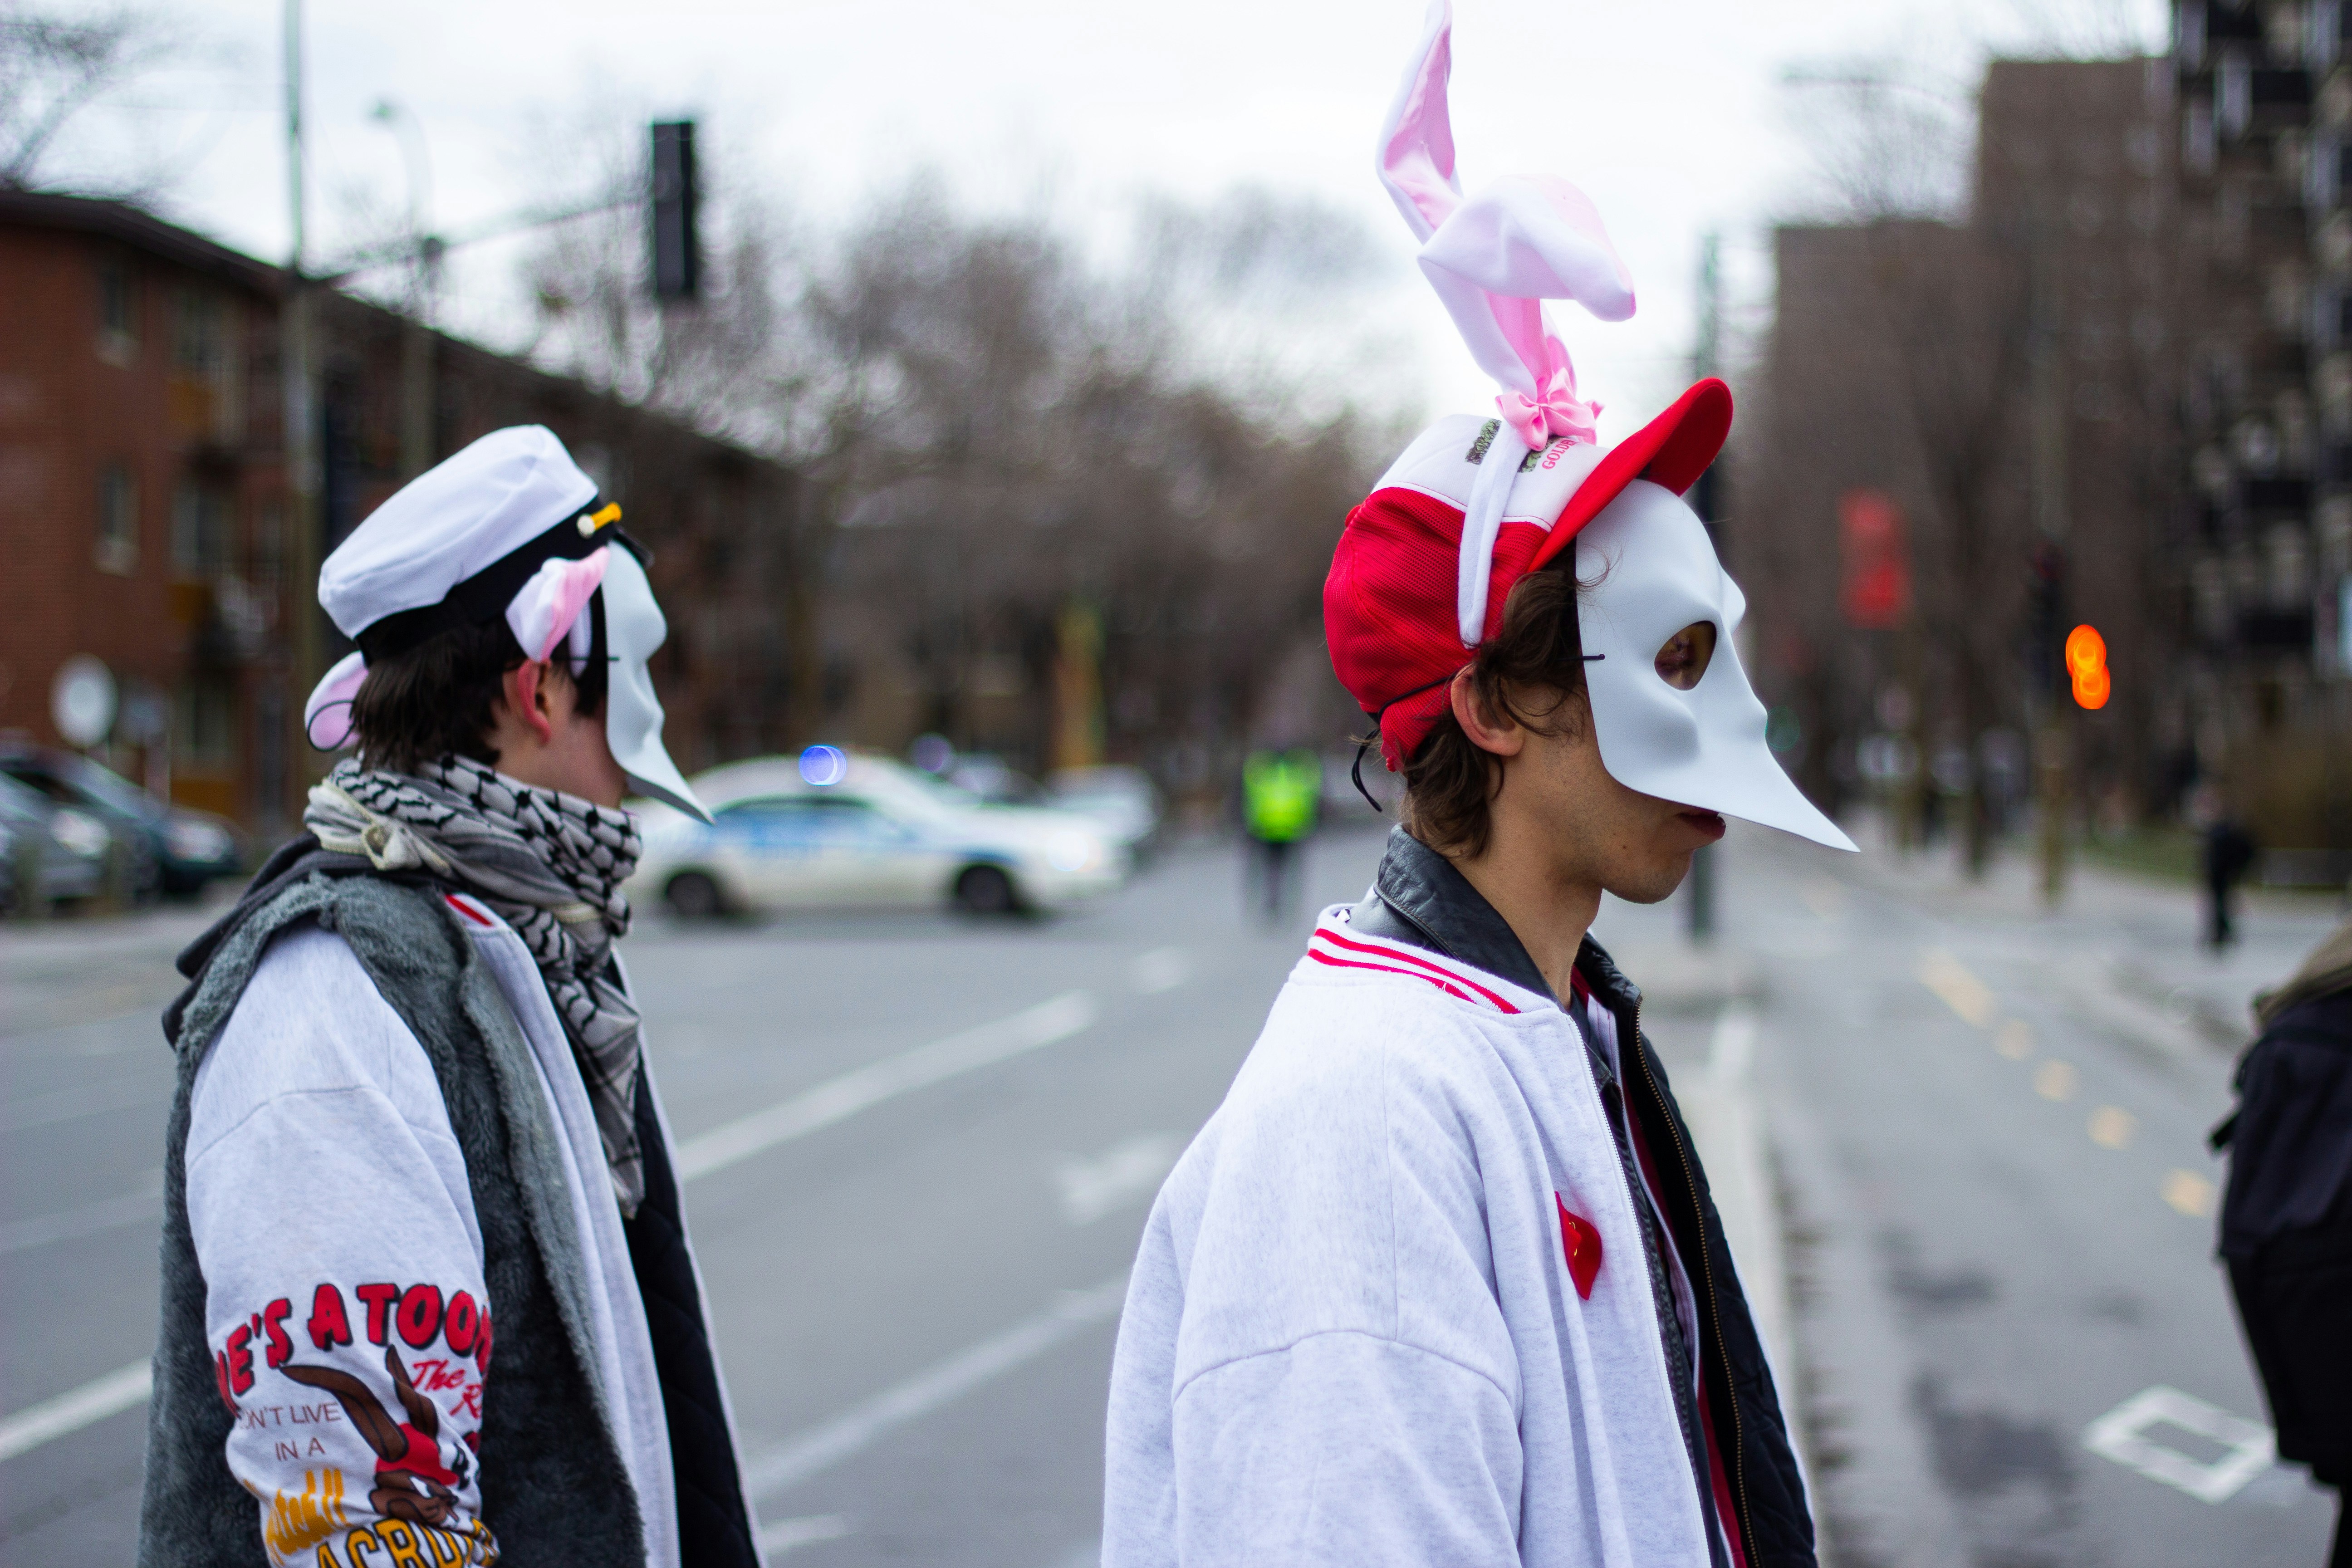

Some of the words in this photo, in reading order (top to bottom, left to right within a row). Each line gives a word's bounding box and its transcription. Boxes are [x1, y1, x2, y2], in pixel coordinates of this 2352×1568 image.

[1542, 439, 1579, 470] GOLDE
[307, 1283, 353, 1352] A
[412, 1359, 466, 1391] The
[289, 1401, 342, 1424] LIVE
[274, 1440, 299, 1462] IN
[307, 1436, 326, 1456] A
